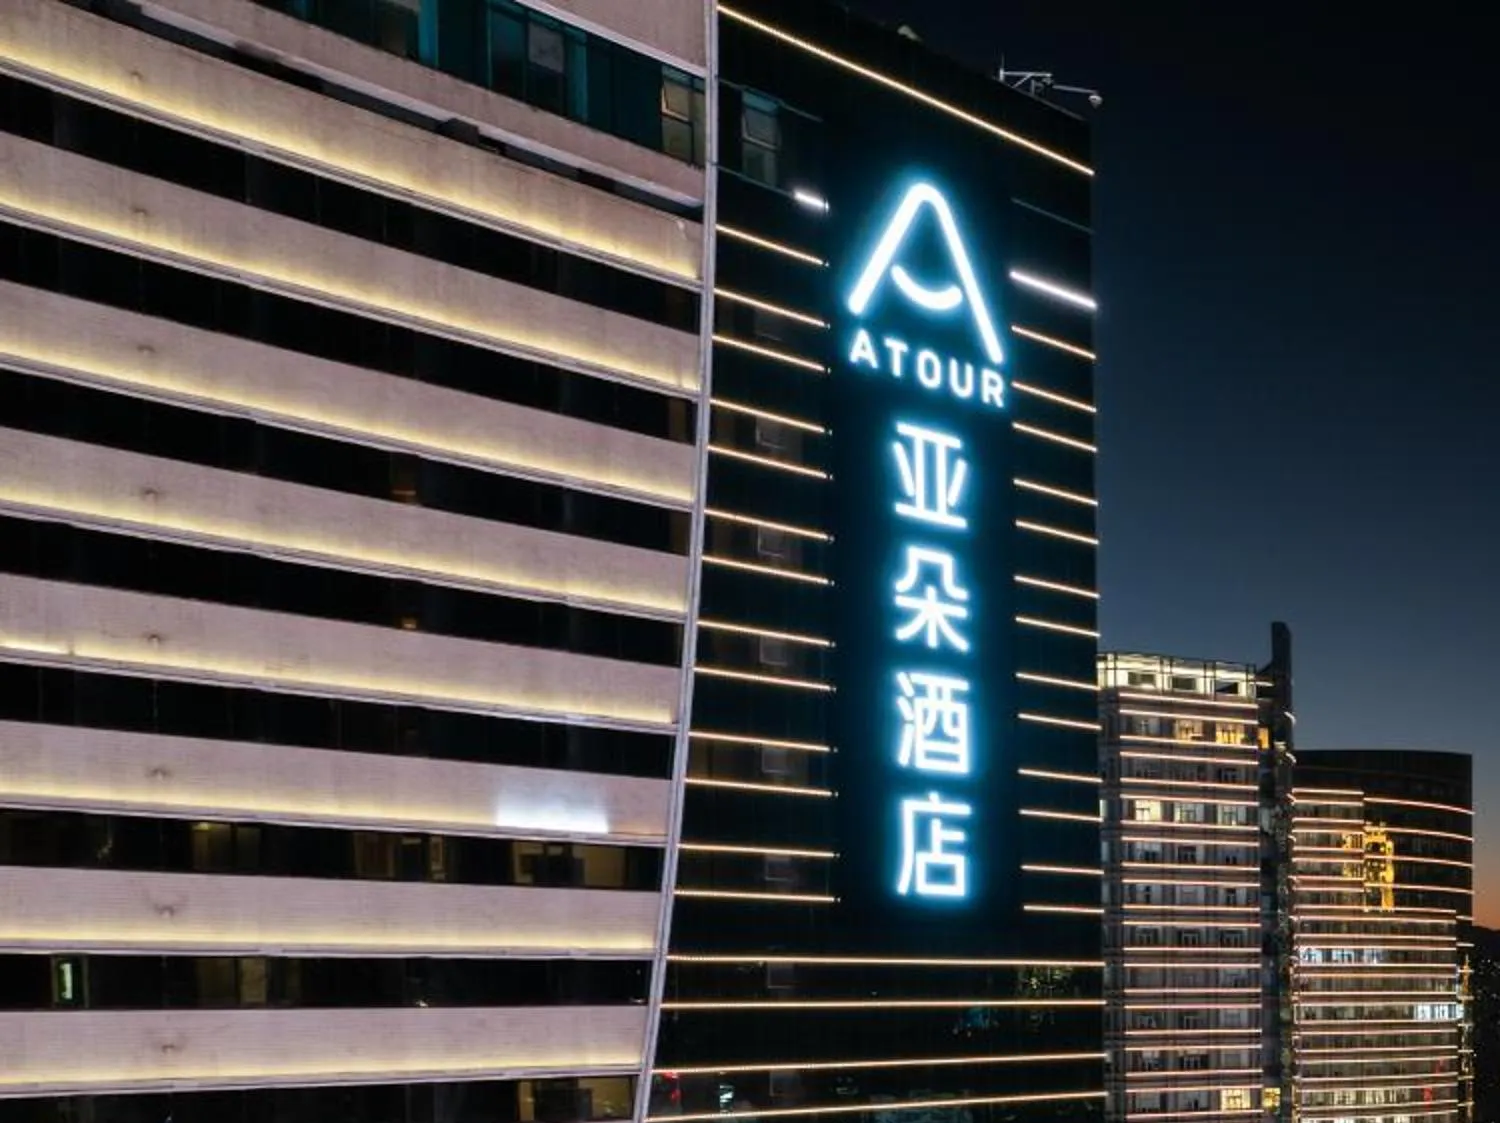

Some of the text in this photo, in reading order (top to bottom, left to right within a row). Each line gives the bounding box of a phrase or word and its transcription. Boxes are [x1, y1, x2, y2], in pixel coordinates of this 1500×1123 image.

[850, 329, 1004, 407] ATOUR
[892, 422, 972, 897] 亚朵酒店
